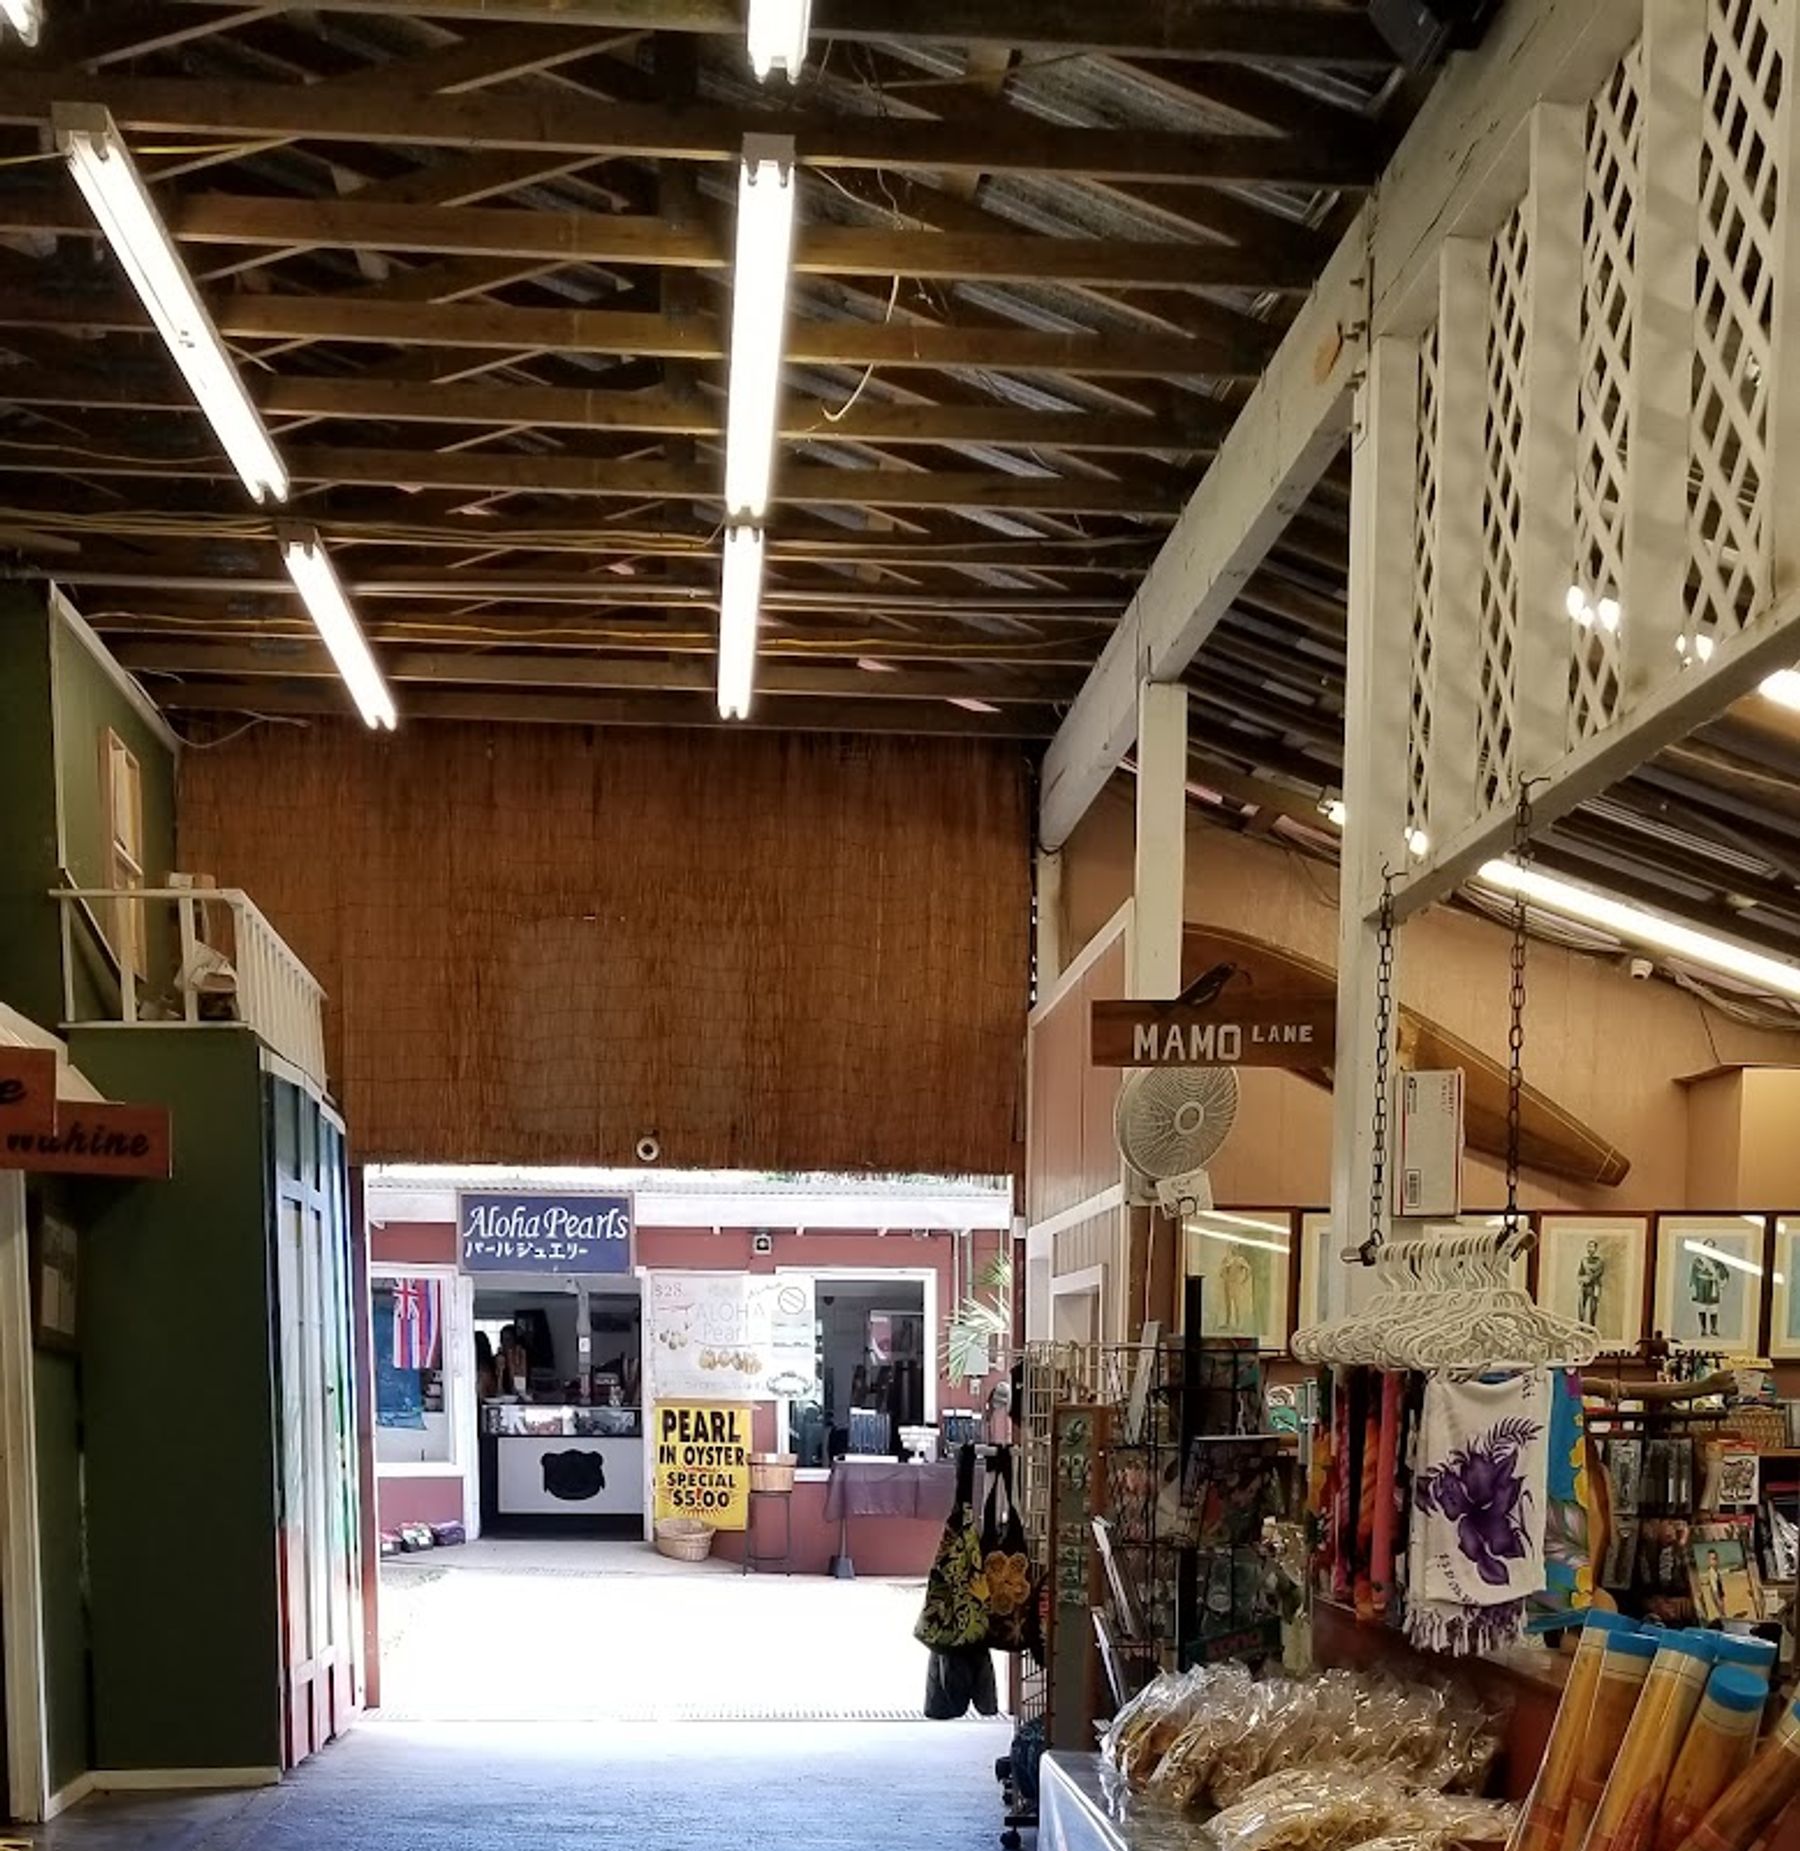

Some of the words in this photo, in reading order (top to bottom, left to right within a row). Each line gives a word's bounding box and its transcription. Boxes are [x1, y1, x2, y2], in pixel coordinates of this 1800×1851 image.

[1133, 1024, 1242, 1061] MAMO
[1252, 1025, 1313, 1042] LANE
[463, 1206, 540, 1238] Aloha
[543, 1207, 629, 1239] Pearls
[662, 1409, 741, 1442] PEARL
[659, 1445, 676, 1465] IN
[683, 1446, 744, 1466] OYSTER
[666, 1472, 736, 1488] SPECIAL
